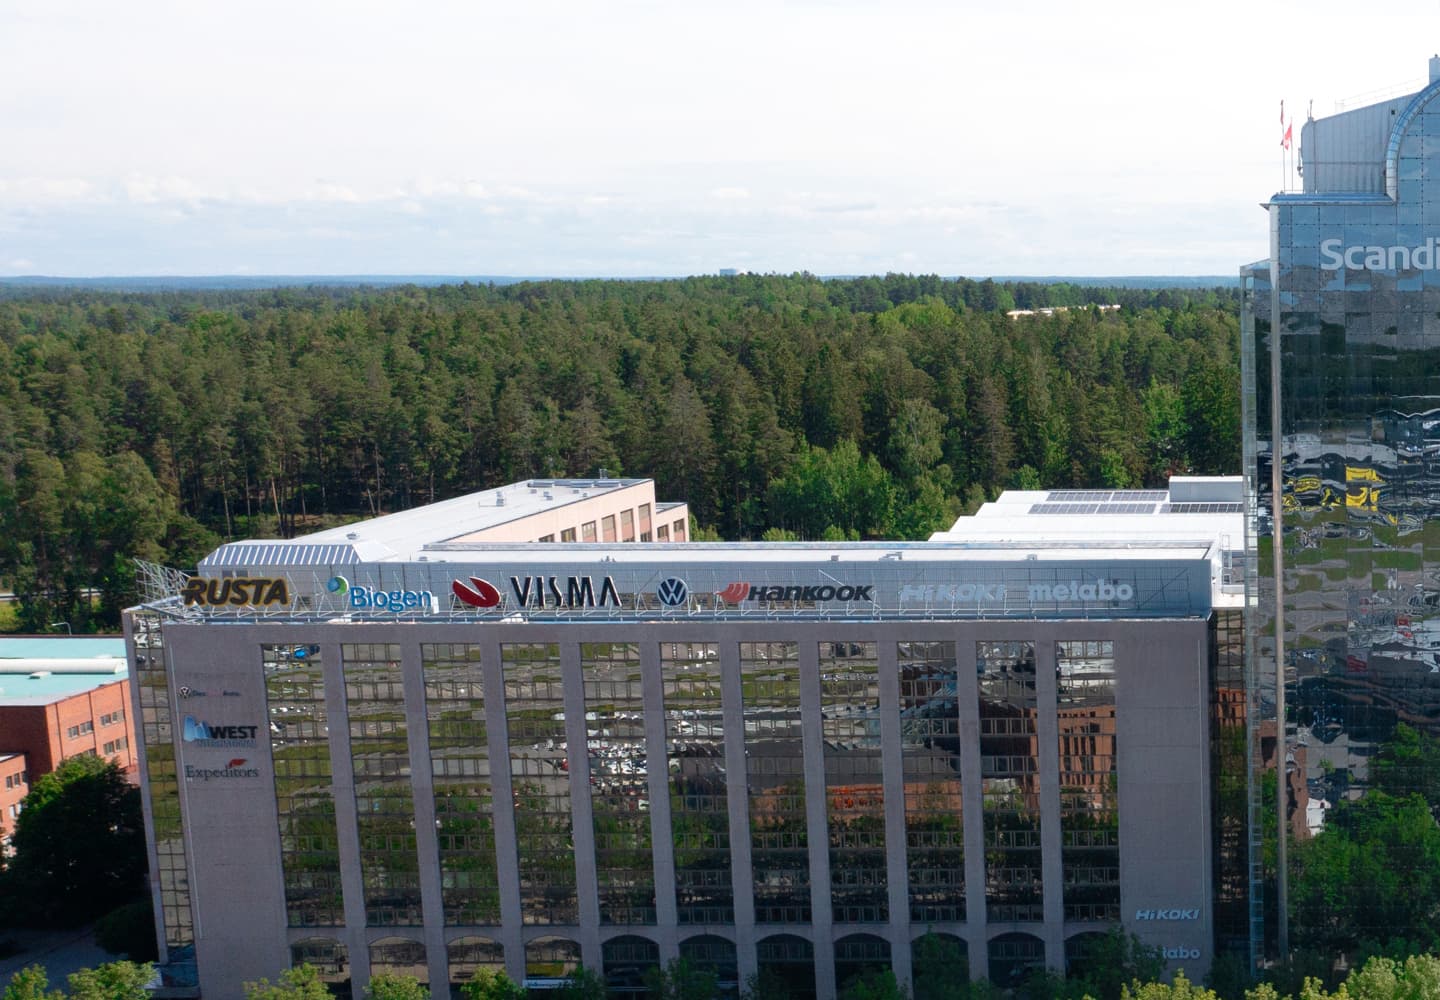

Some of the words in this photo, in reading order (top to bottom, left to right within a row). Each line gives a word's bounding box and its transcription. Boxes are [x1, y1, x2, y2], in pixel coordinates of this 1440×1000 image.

[181, 576, 290, 607] RUSTA
[350, 585, 433, 613] Biogen
[510, 575, 622, 607] VISMA
[1028, 578, 1134, 601] metabo
[208, 726, 258, 740] WEST
[185, 765, 260, 781] Expeditors
[1135, 908, 1200, 920] HiKOKI
